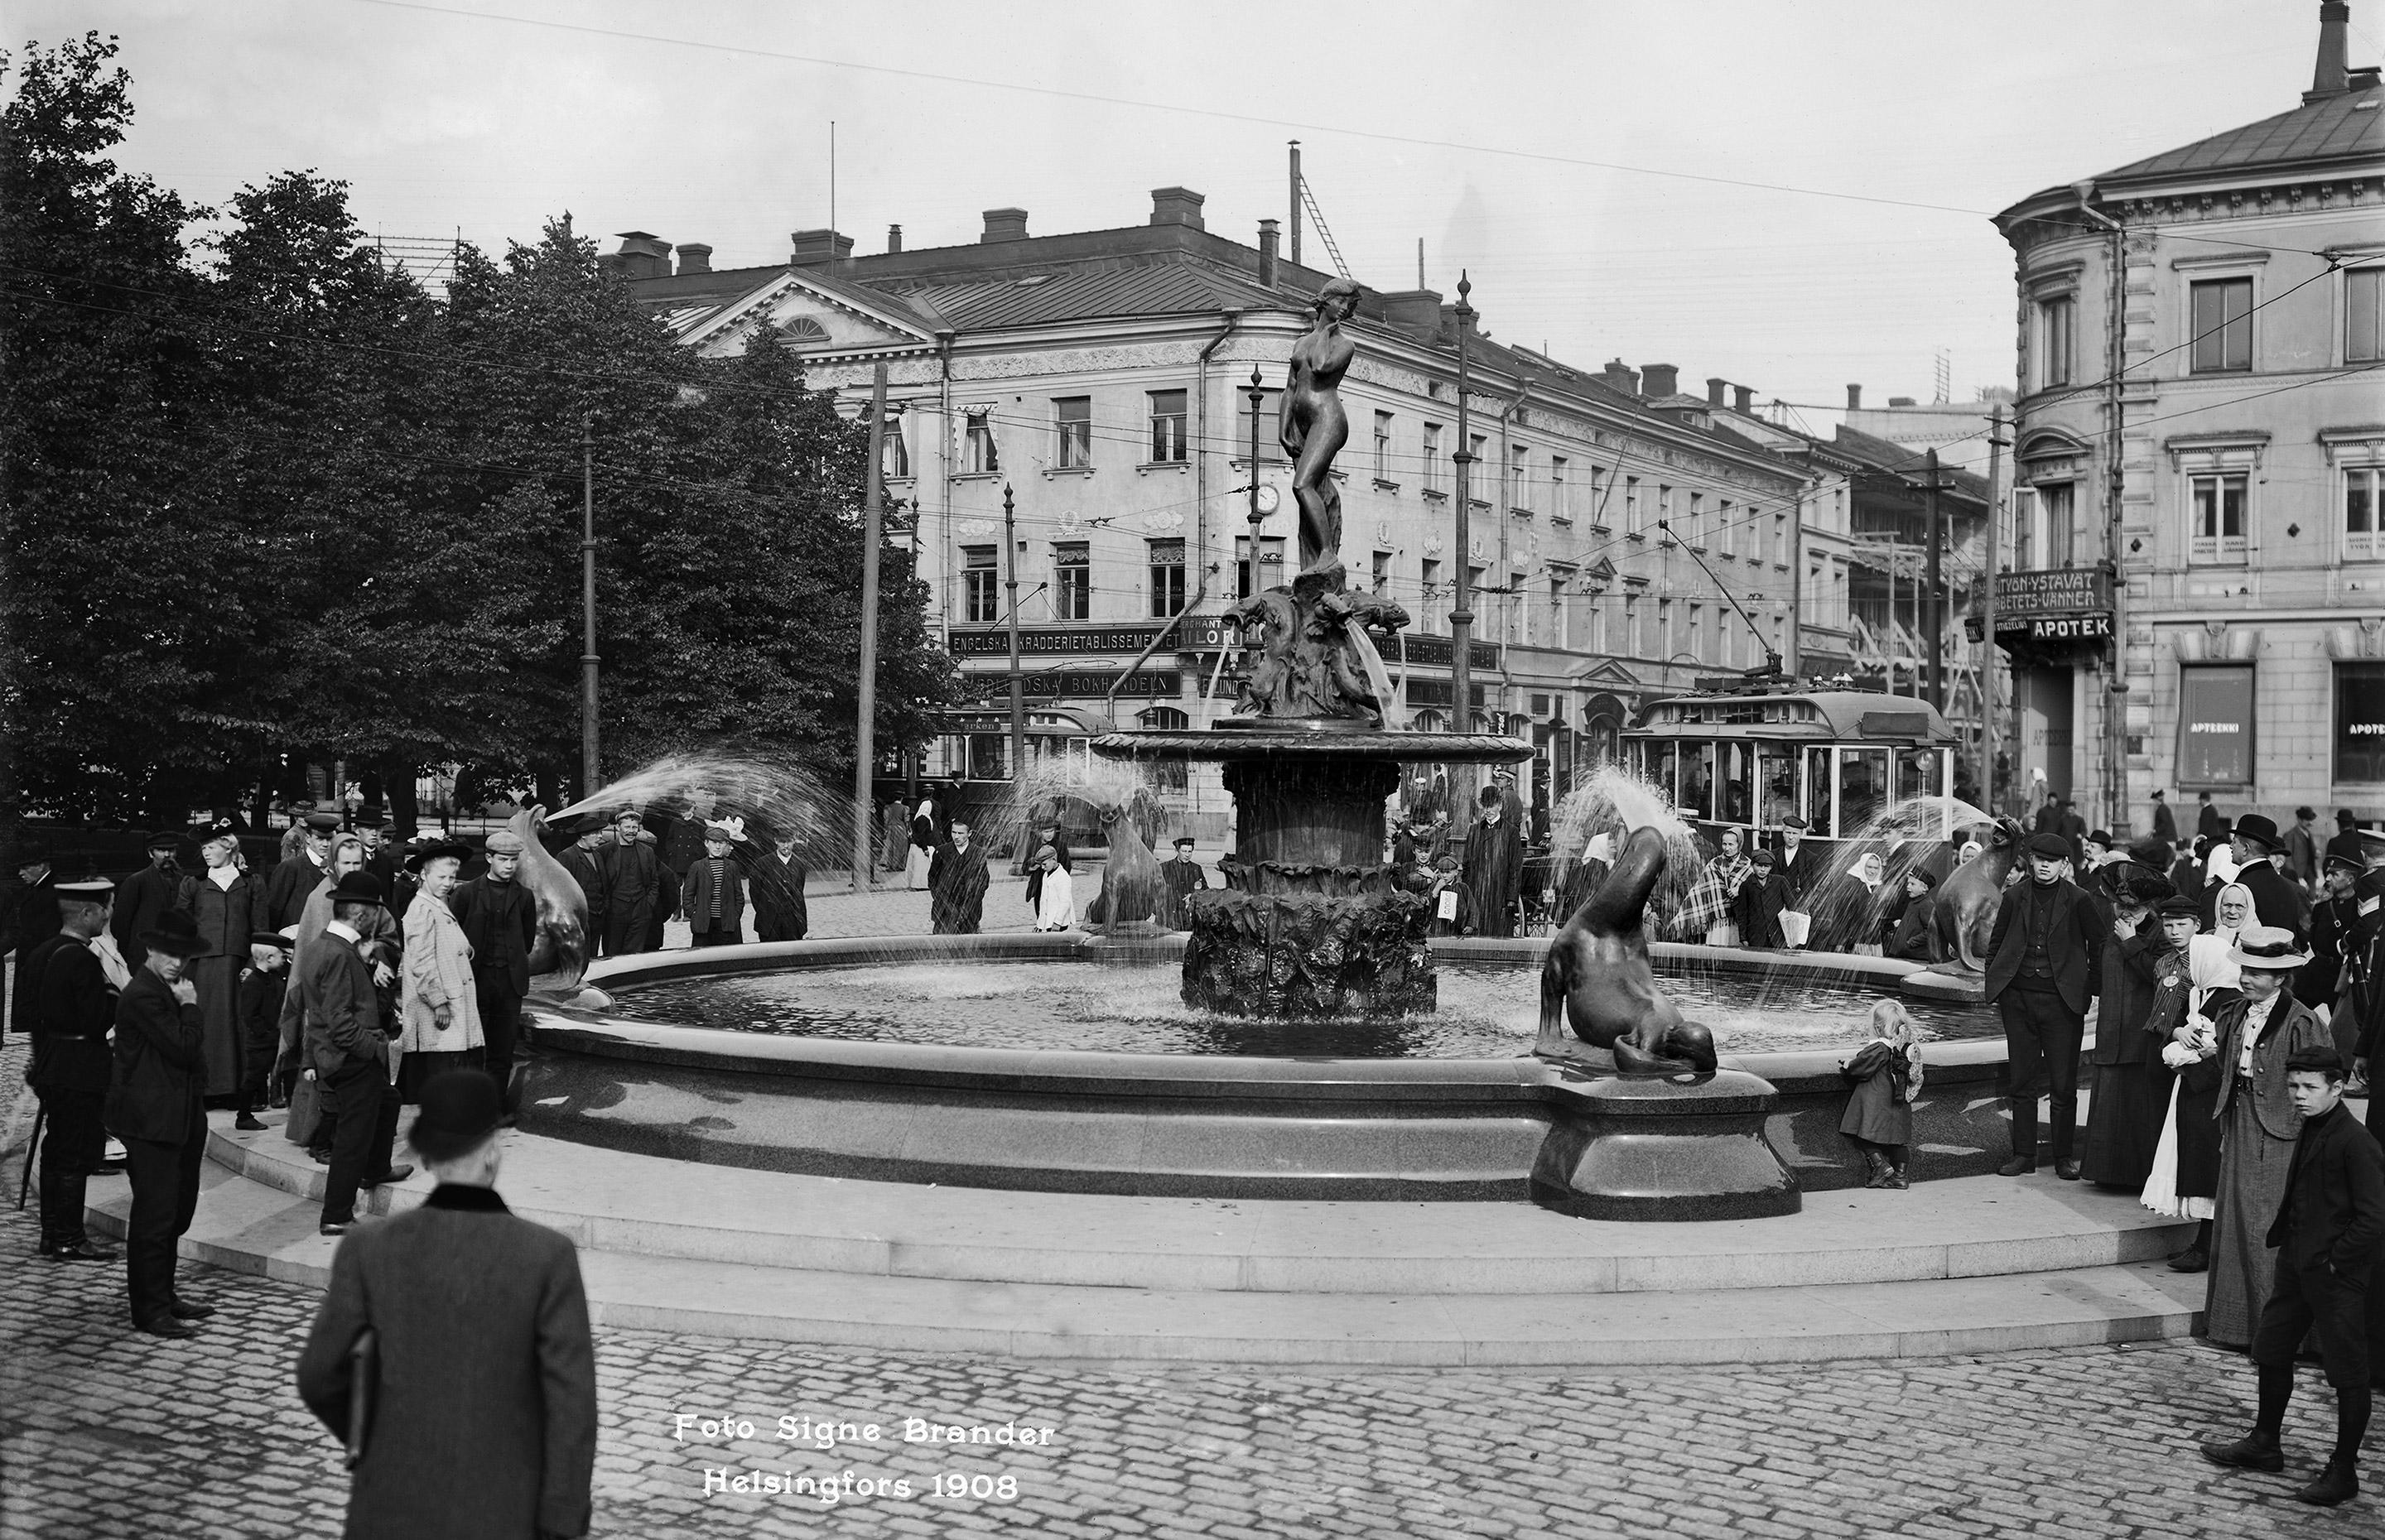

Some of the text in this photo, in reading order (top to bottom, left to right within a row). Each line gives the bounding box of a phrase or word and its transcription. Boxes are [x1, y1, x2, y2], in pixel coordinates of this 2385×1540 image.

[1994, 593, 2038, 611] RBETETS
[1181, 619, 1221, 629] ERCHANT
[2035, 618, 2110, 637] APOTEK
[954, 636, 1008, 651] ENGELSKA
[1181, 630, 1235, 644] AILOR
[2349, 723, 2385, 735] APOTE
